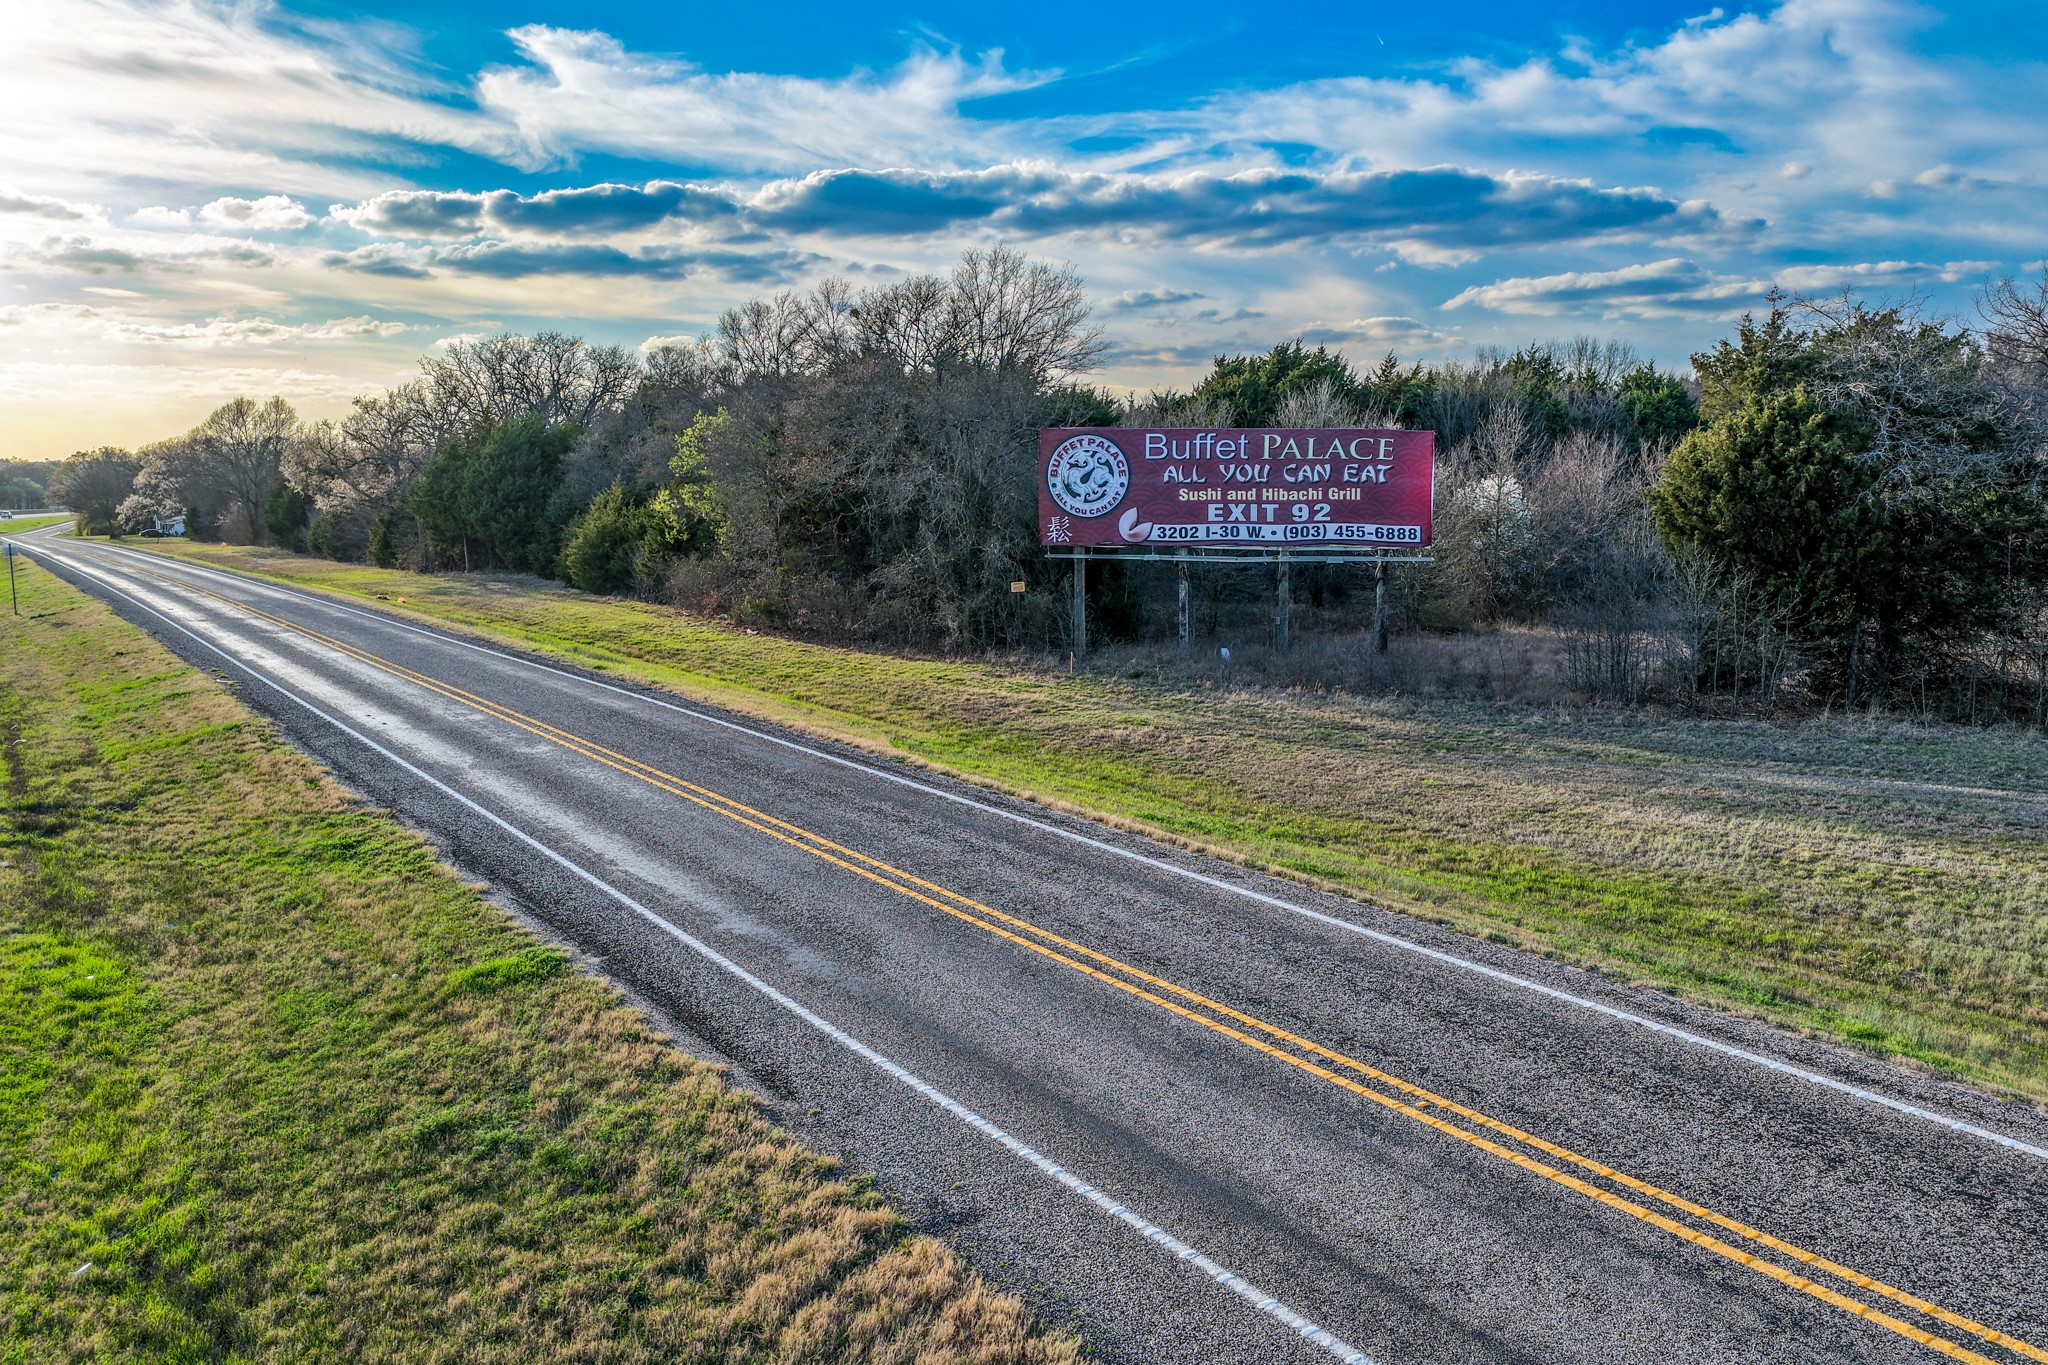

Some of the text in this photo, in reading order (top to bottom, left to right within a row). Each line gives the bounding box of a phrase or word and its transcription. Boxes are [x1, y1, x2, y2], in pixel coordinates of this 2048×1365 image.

[1050, 438, 1127, 478] BUFFET PALACE
[1145, 433, 1395, 460] Buffet PALACE
[1163, 463, 1395, 484] ALL YOU CAN EAT
[1055, 490, 1122, 515] ALL YOU CAN EAT
[1179, 487, 1361, 501] Sushi and Hibachi Grill
[1207, 503, 1331, 522] EXIT 92
[1047, 516, 1073, 543] 鬆
[1157, 524, 1418, 541] 3202 I-30 W. (903) 455-6888
